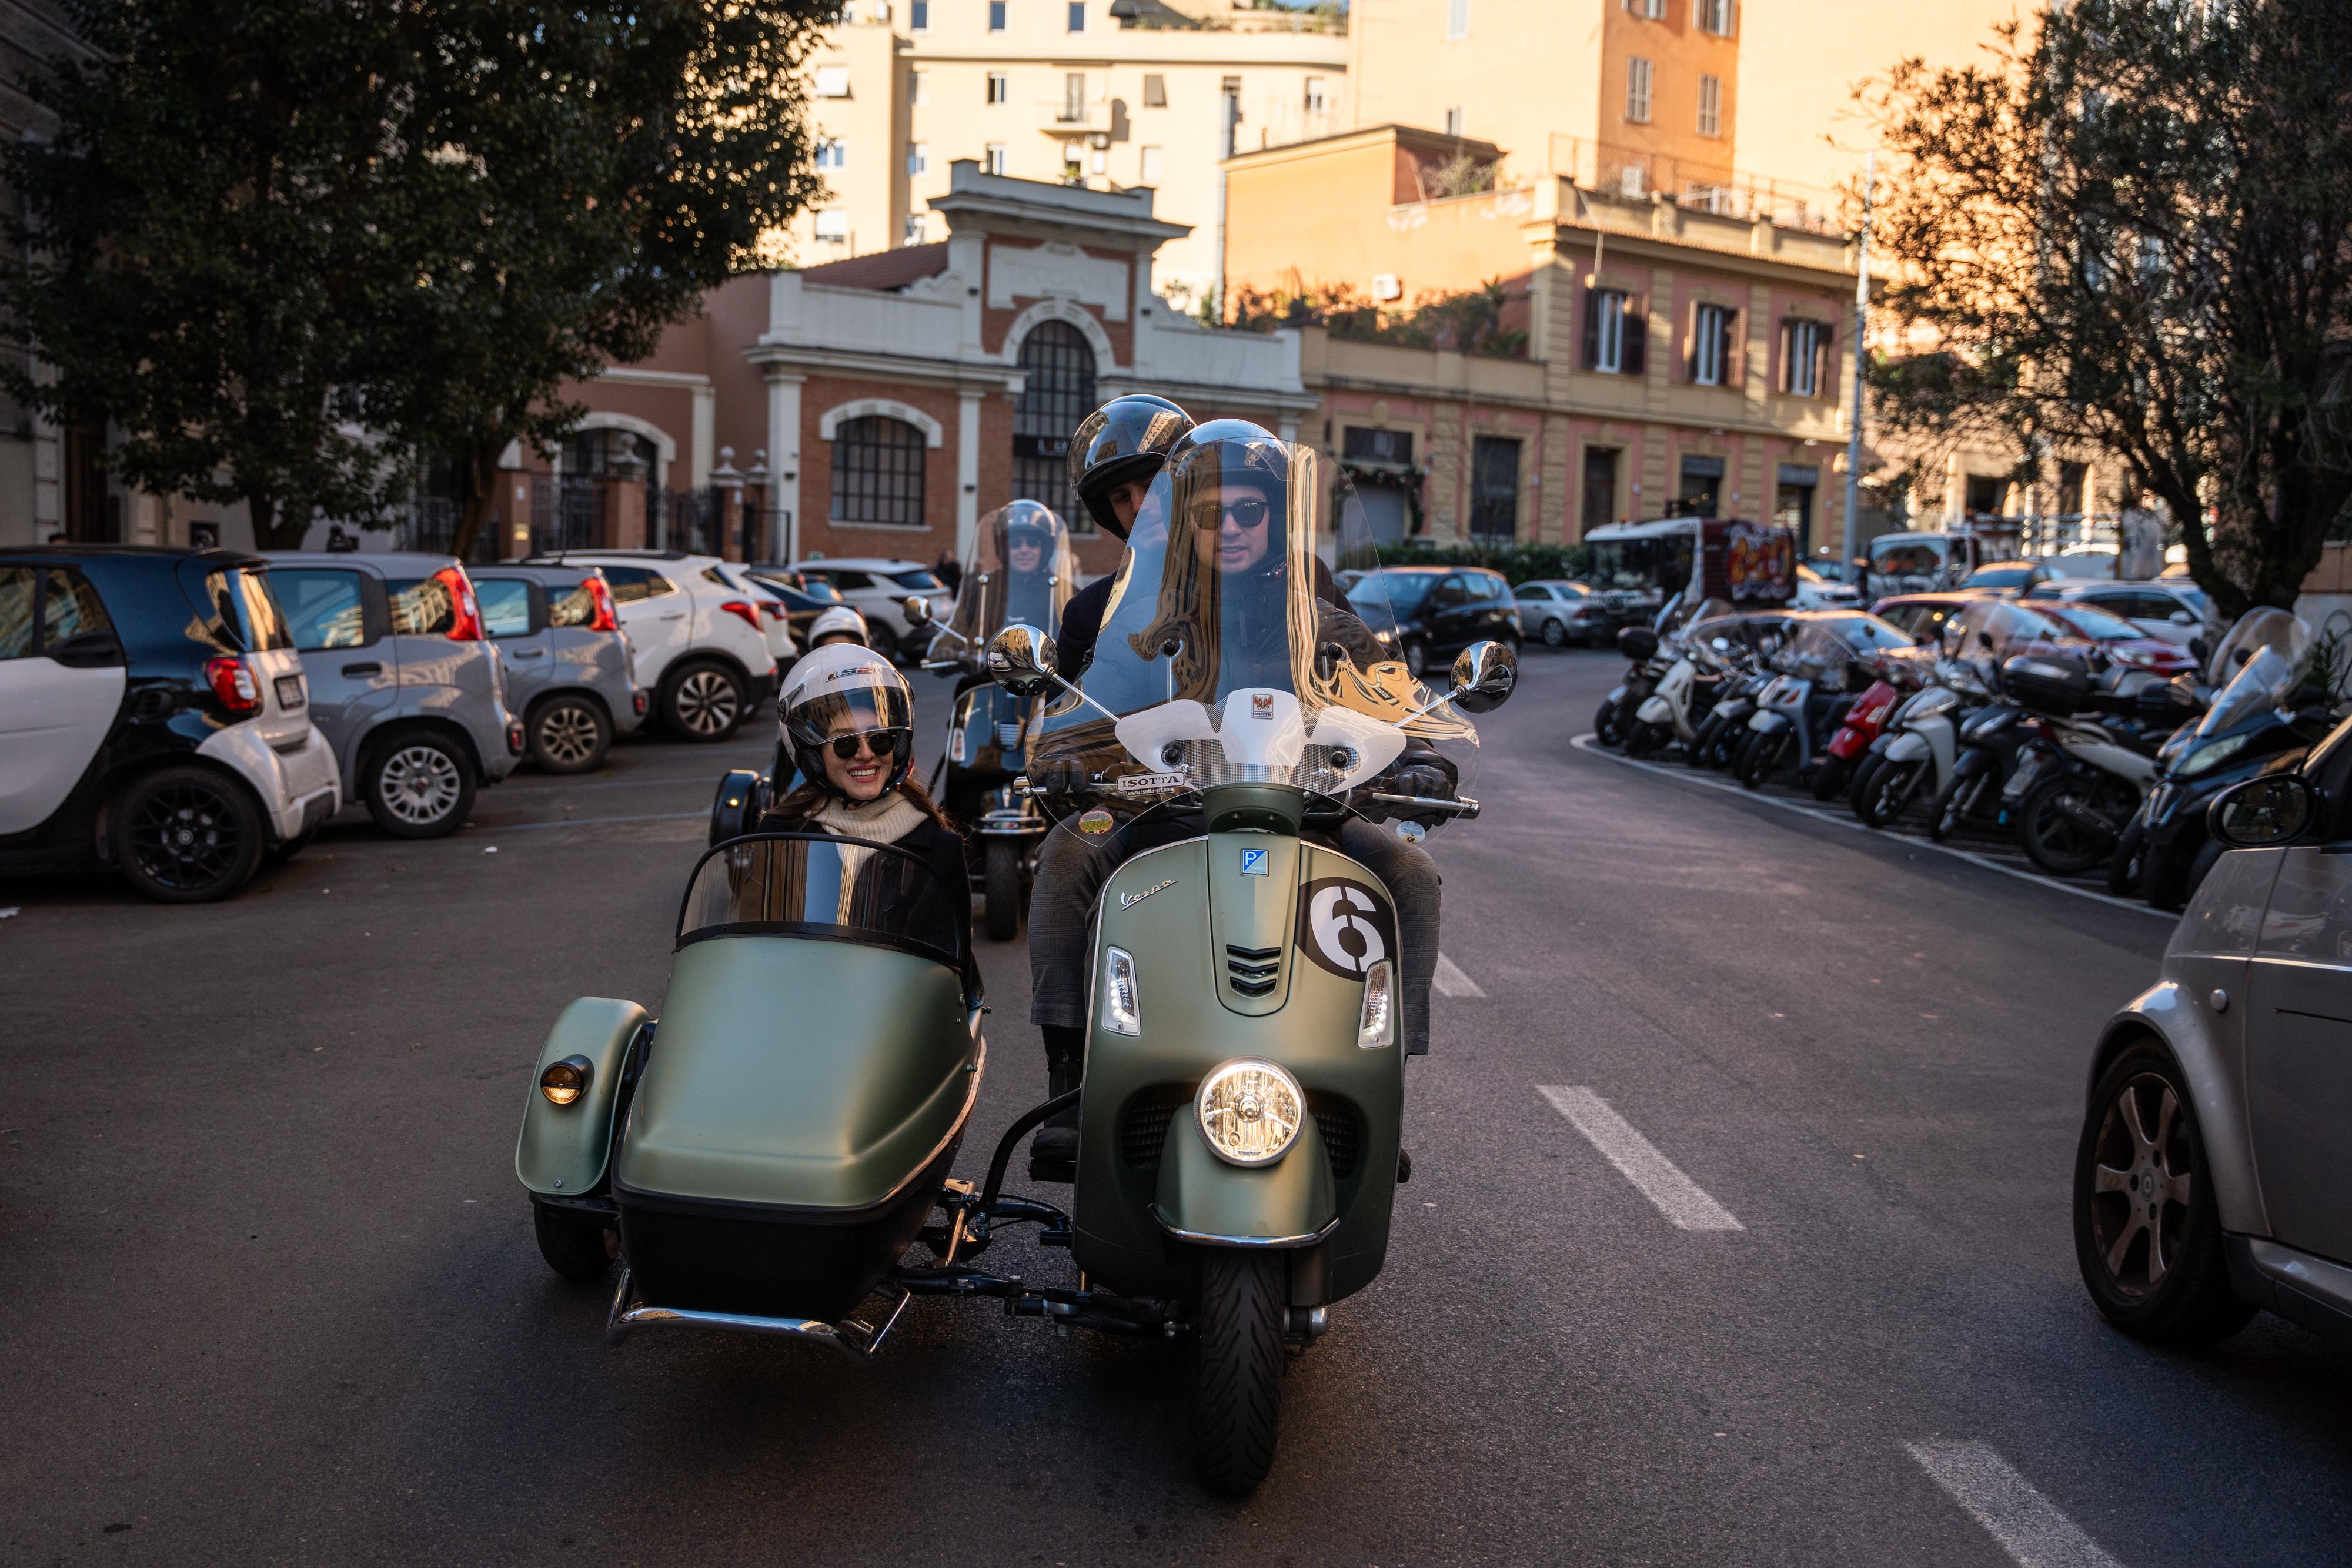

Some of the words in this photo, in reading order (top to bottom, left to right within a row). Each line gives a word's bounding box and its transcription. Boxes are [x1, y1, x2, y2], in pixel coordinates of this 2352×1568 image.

[826, 667, 874, 681] LS2
[1122, 776, 1180, 787] ISOTTA
[1127, 787, 1174, 796] www.isotta-srl.com
[1245, 851, 1257, 865] P
[1120, 879, 1178, 911] Vespa
[1310, 885, 1385, 972] 6
